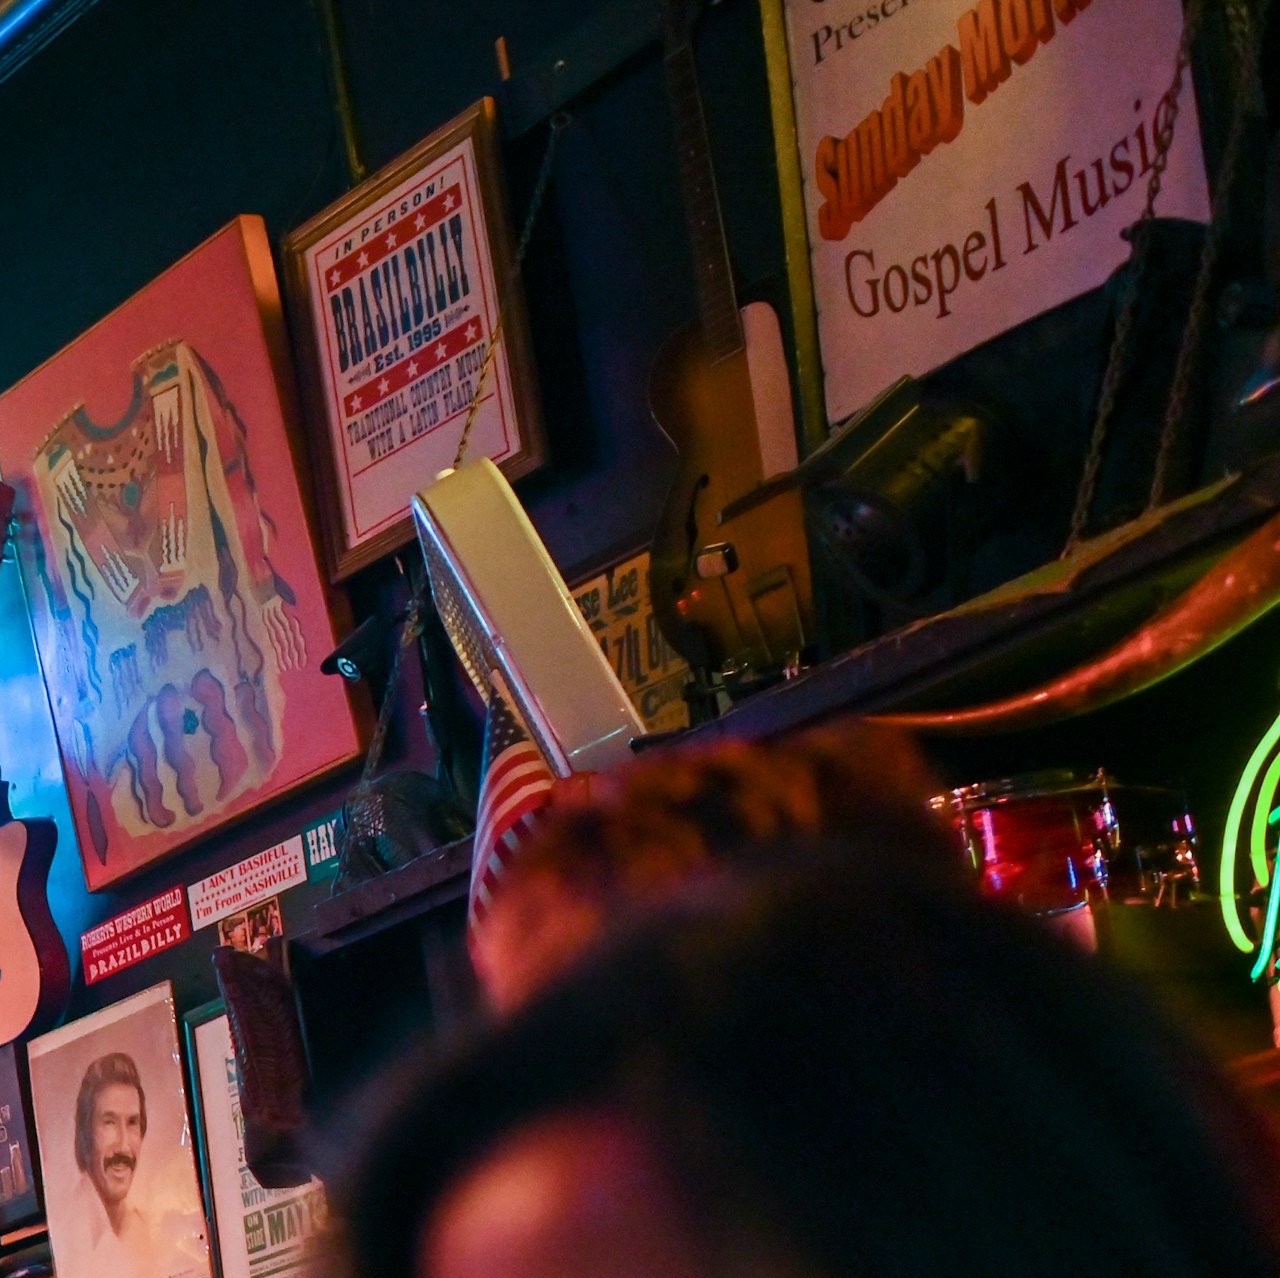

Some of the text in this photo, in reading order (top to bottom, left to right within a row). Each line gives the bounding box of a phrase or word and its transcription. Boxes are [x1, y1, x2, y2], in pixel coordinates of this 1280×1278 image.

[815, 44, 964, 241] Sunday
[335, 176, 444, 259] IN PERSON!
[844, 95, 1180, 320] Gospel Music
[331, 213, 470, 373] BRASILBILLY
[374, 318, 441, 373] Est. 1995
[347, 392, 408, 446] TRADITIONAL
[410, 364, 452, 408] COUNTRY
[367, 380, 475, 460] WITH A LATIN FLAIR
[196, 906, 212, 920] I'm
[215, 893, 242, 911] From
[244, 863, 300, 897] NASHVILLE
[201, 845, 288, 893] I AIN'T BASHFUL
[115, 903, 153, 934] WESTERN
[153, 888, 182, 915] WORLD
[246, 1214, 259, 1227] ON
